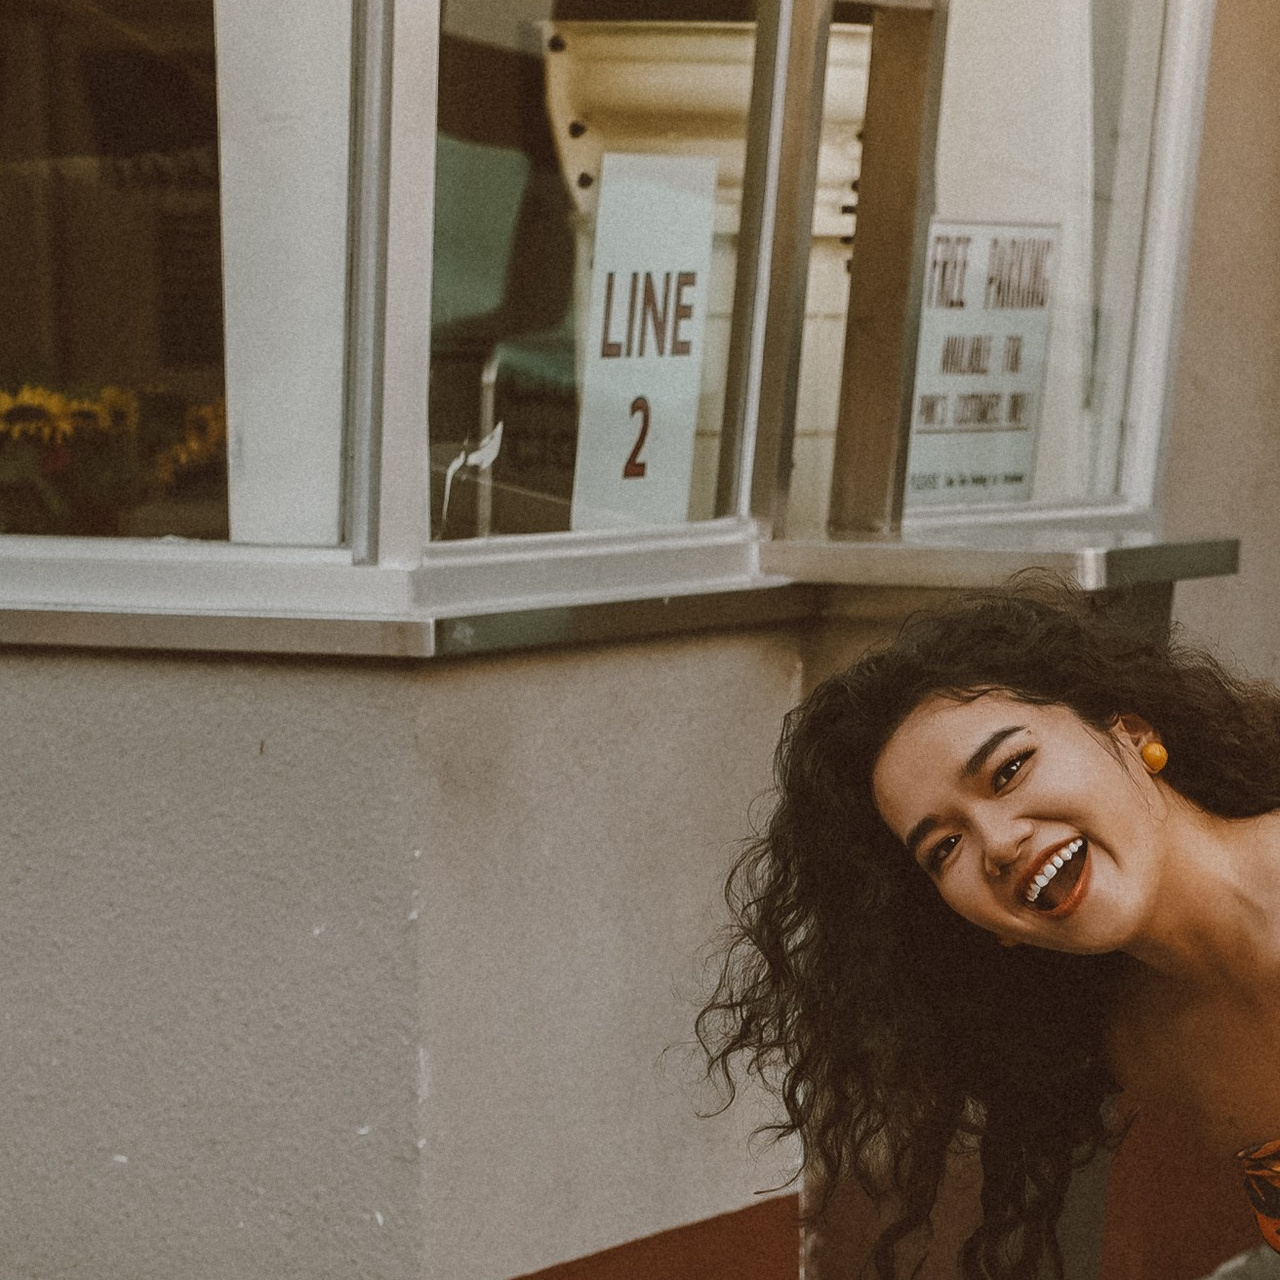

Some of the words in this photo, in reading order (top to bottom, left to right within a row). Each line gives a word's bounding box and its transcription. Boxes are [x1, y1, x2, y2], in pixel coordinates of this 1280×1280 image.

[925, 236, 971, 309] FREE
[601, 272, 697, 358] LINE
[622, 395, 652, 479] 2
